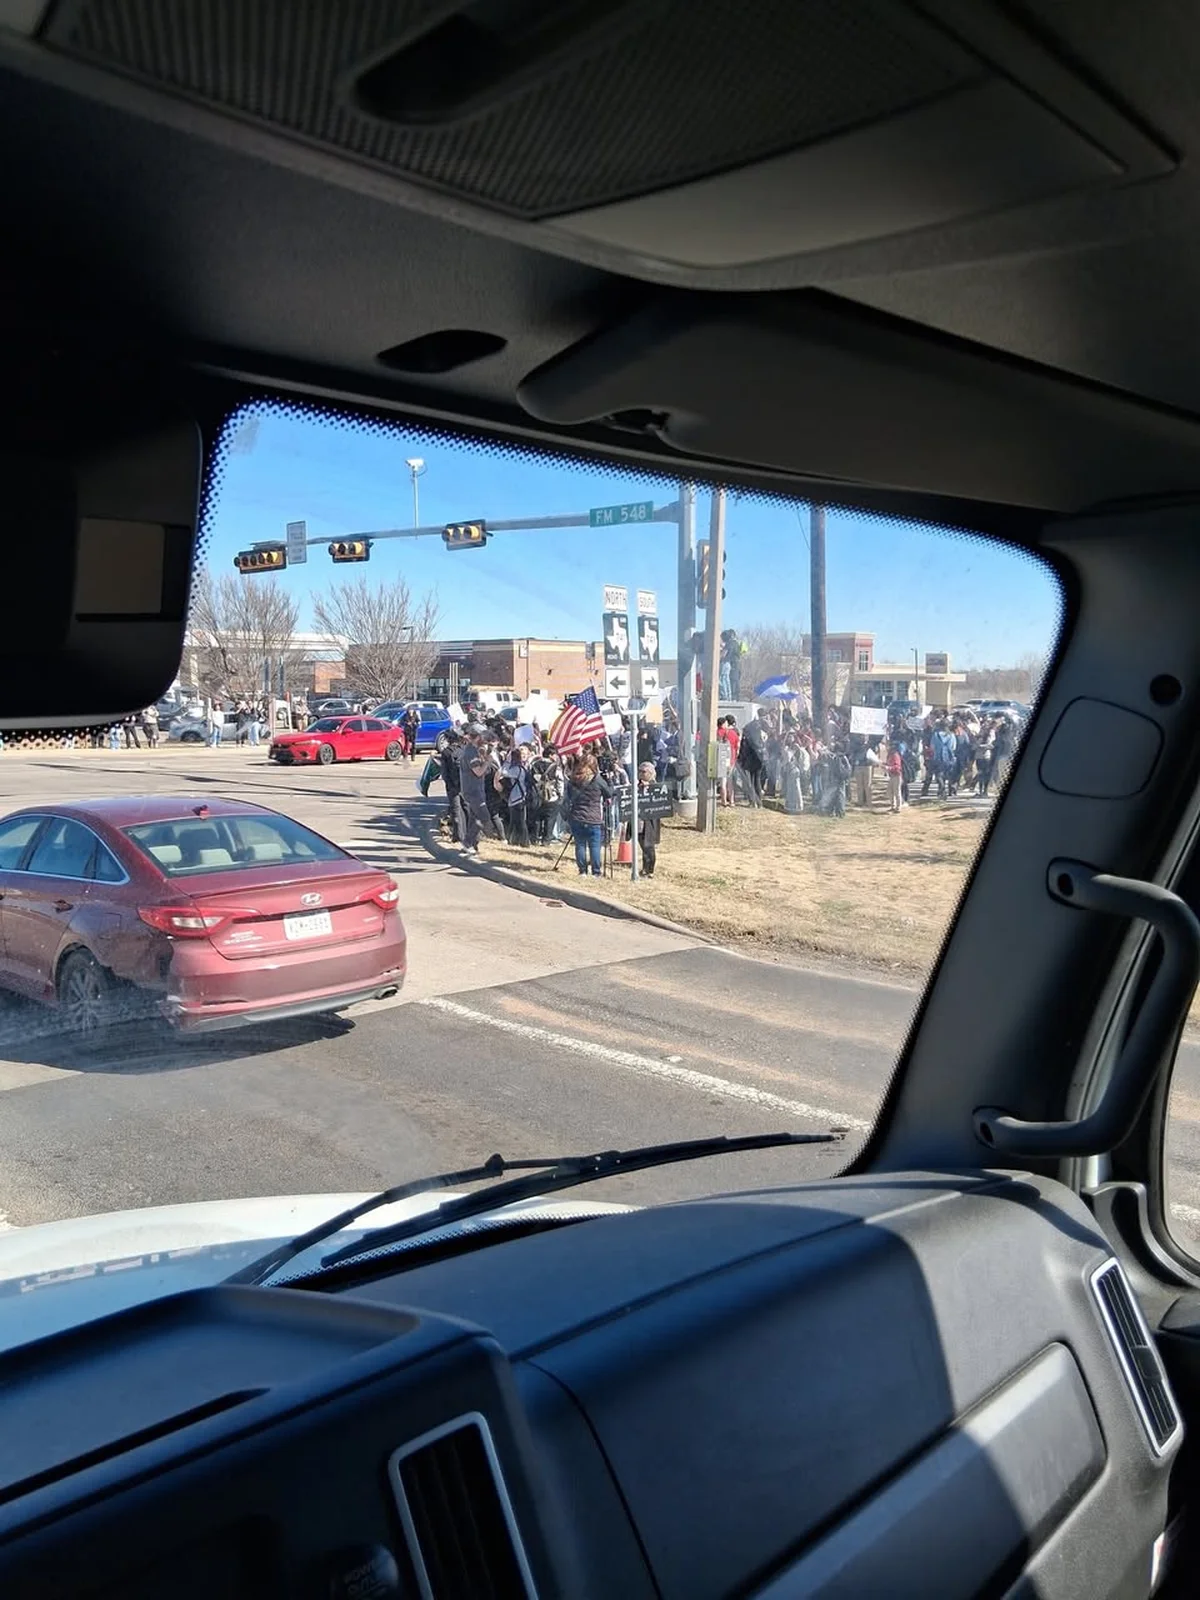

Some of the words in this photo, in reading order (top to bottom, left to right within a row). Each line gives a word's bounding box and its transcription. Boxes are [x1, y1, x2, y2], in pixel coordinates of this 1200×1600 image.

[596, 509, 613, 525] FM
[620, 504, 646, 522] 548
[605, 591, 626, 605] NORTH
[639, 596, 655, 608] SOUTH
